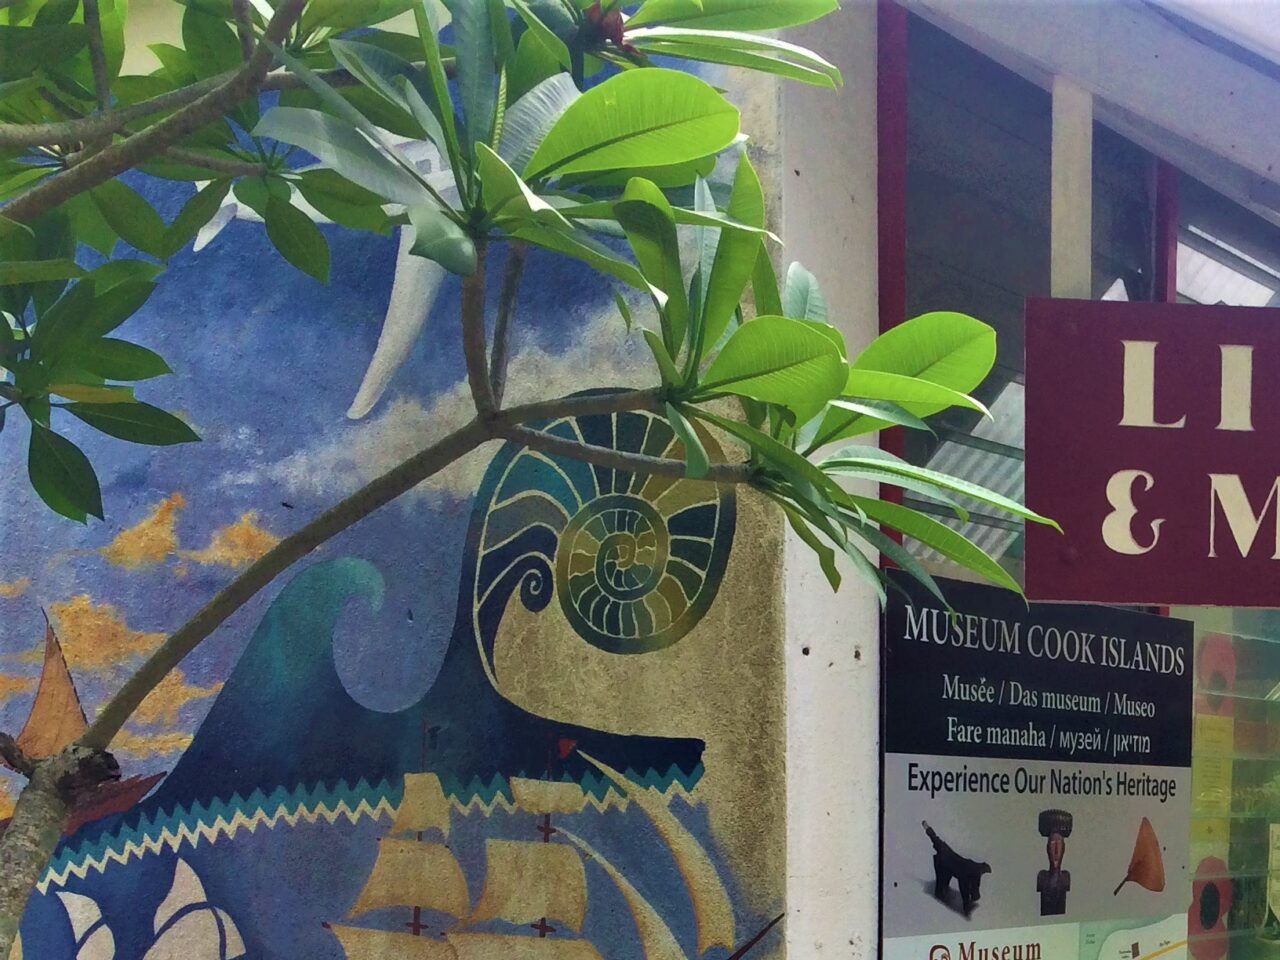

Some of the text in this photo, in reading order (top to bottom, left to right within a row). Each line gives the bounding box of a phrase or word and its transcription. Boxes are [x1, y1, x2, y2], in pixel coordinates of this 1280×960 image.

[1102, 468, 1166, 555] &
[903, 604, 1186, 677] MUSEUM COOK ISLANDS
[941, 673, 1156, 718] Musée / Das museum / Museo
[946, 716, 1056, 749] Fare manaha /
[1059, 728, 1101, 756] музей
[1113, 733, 1151, 757] מוזיאון
[907, 762, 1177, 803] Experience Our Nation's Heritage
